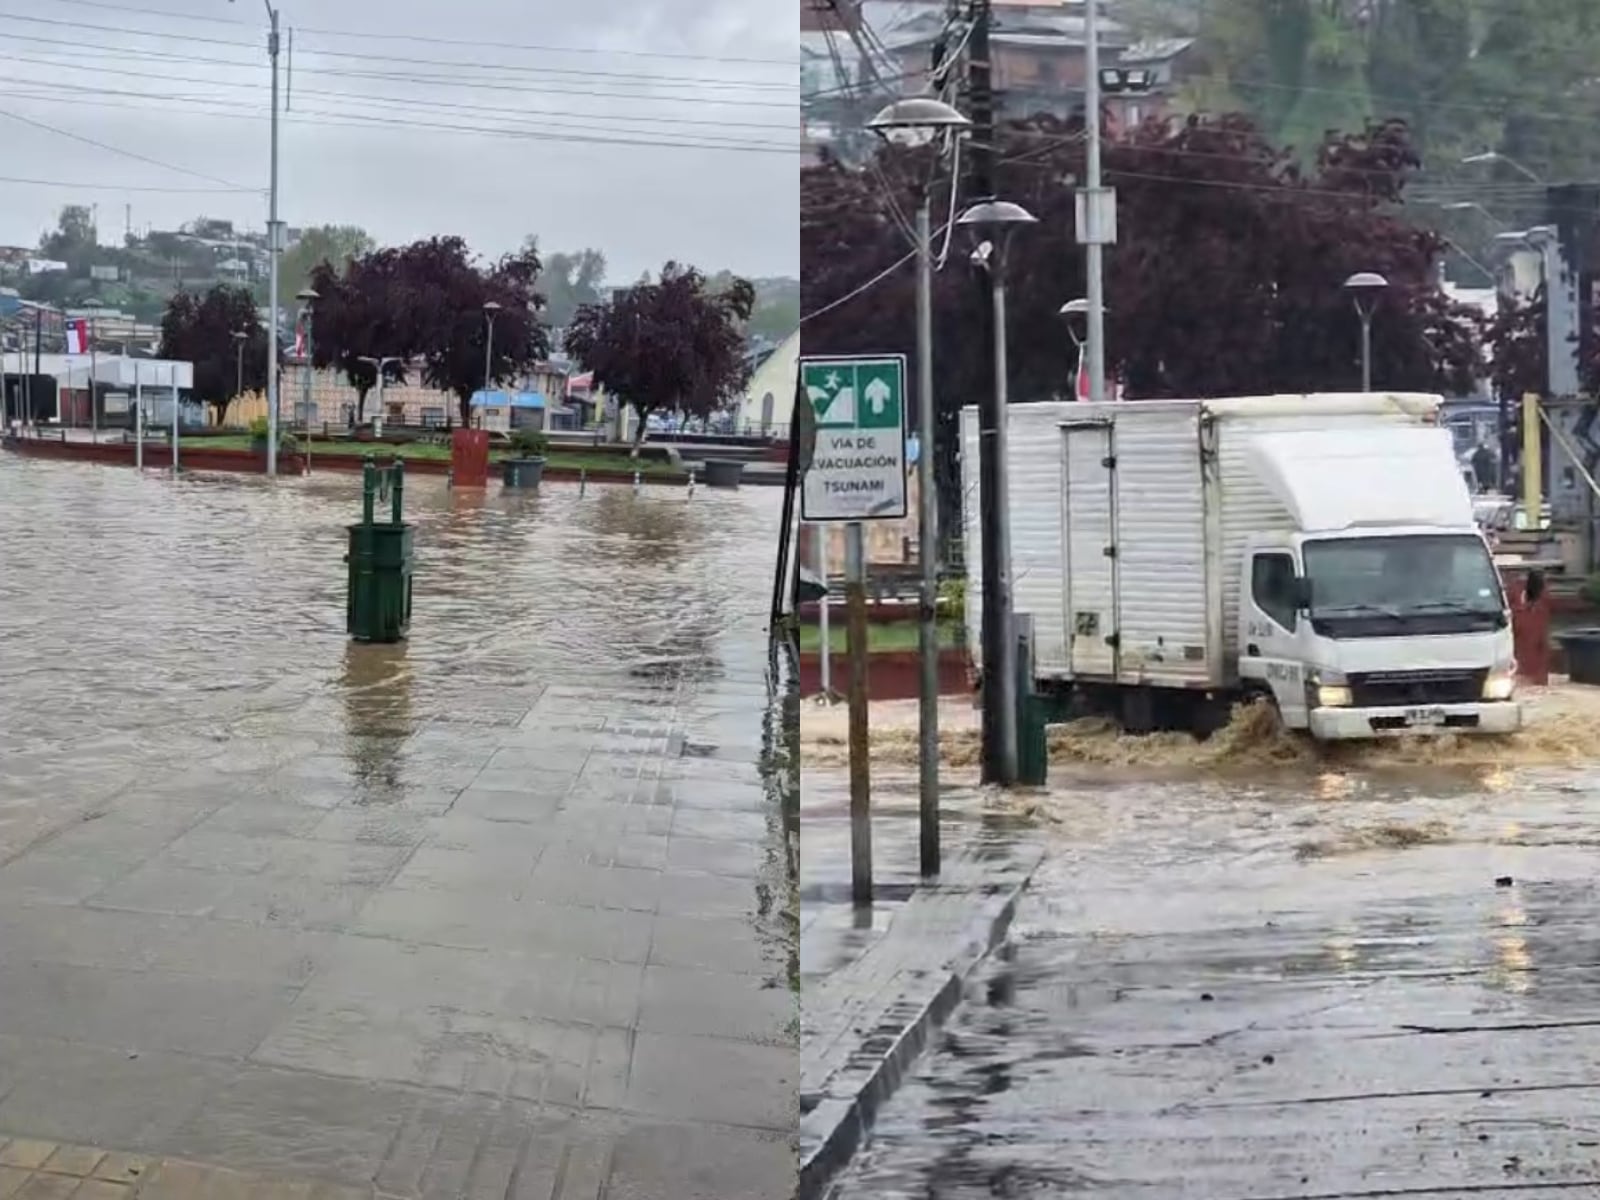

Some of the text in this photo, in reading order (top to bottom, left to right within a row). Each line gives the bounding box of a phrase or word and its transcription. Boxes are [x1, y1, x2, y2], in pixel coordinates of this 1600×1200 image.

[857, 437, 875, 449] DE
[813, 455, 897, 469] VACUACIÓN
[824, 480, 884, 493] TSUNAMI
